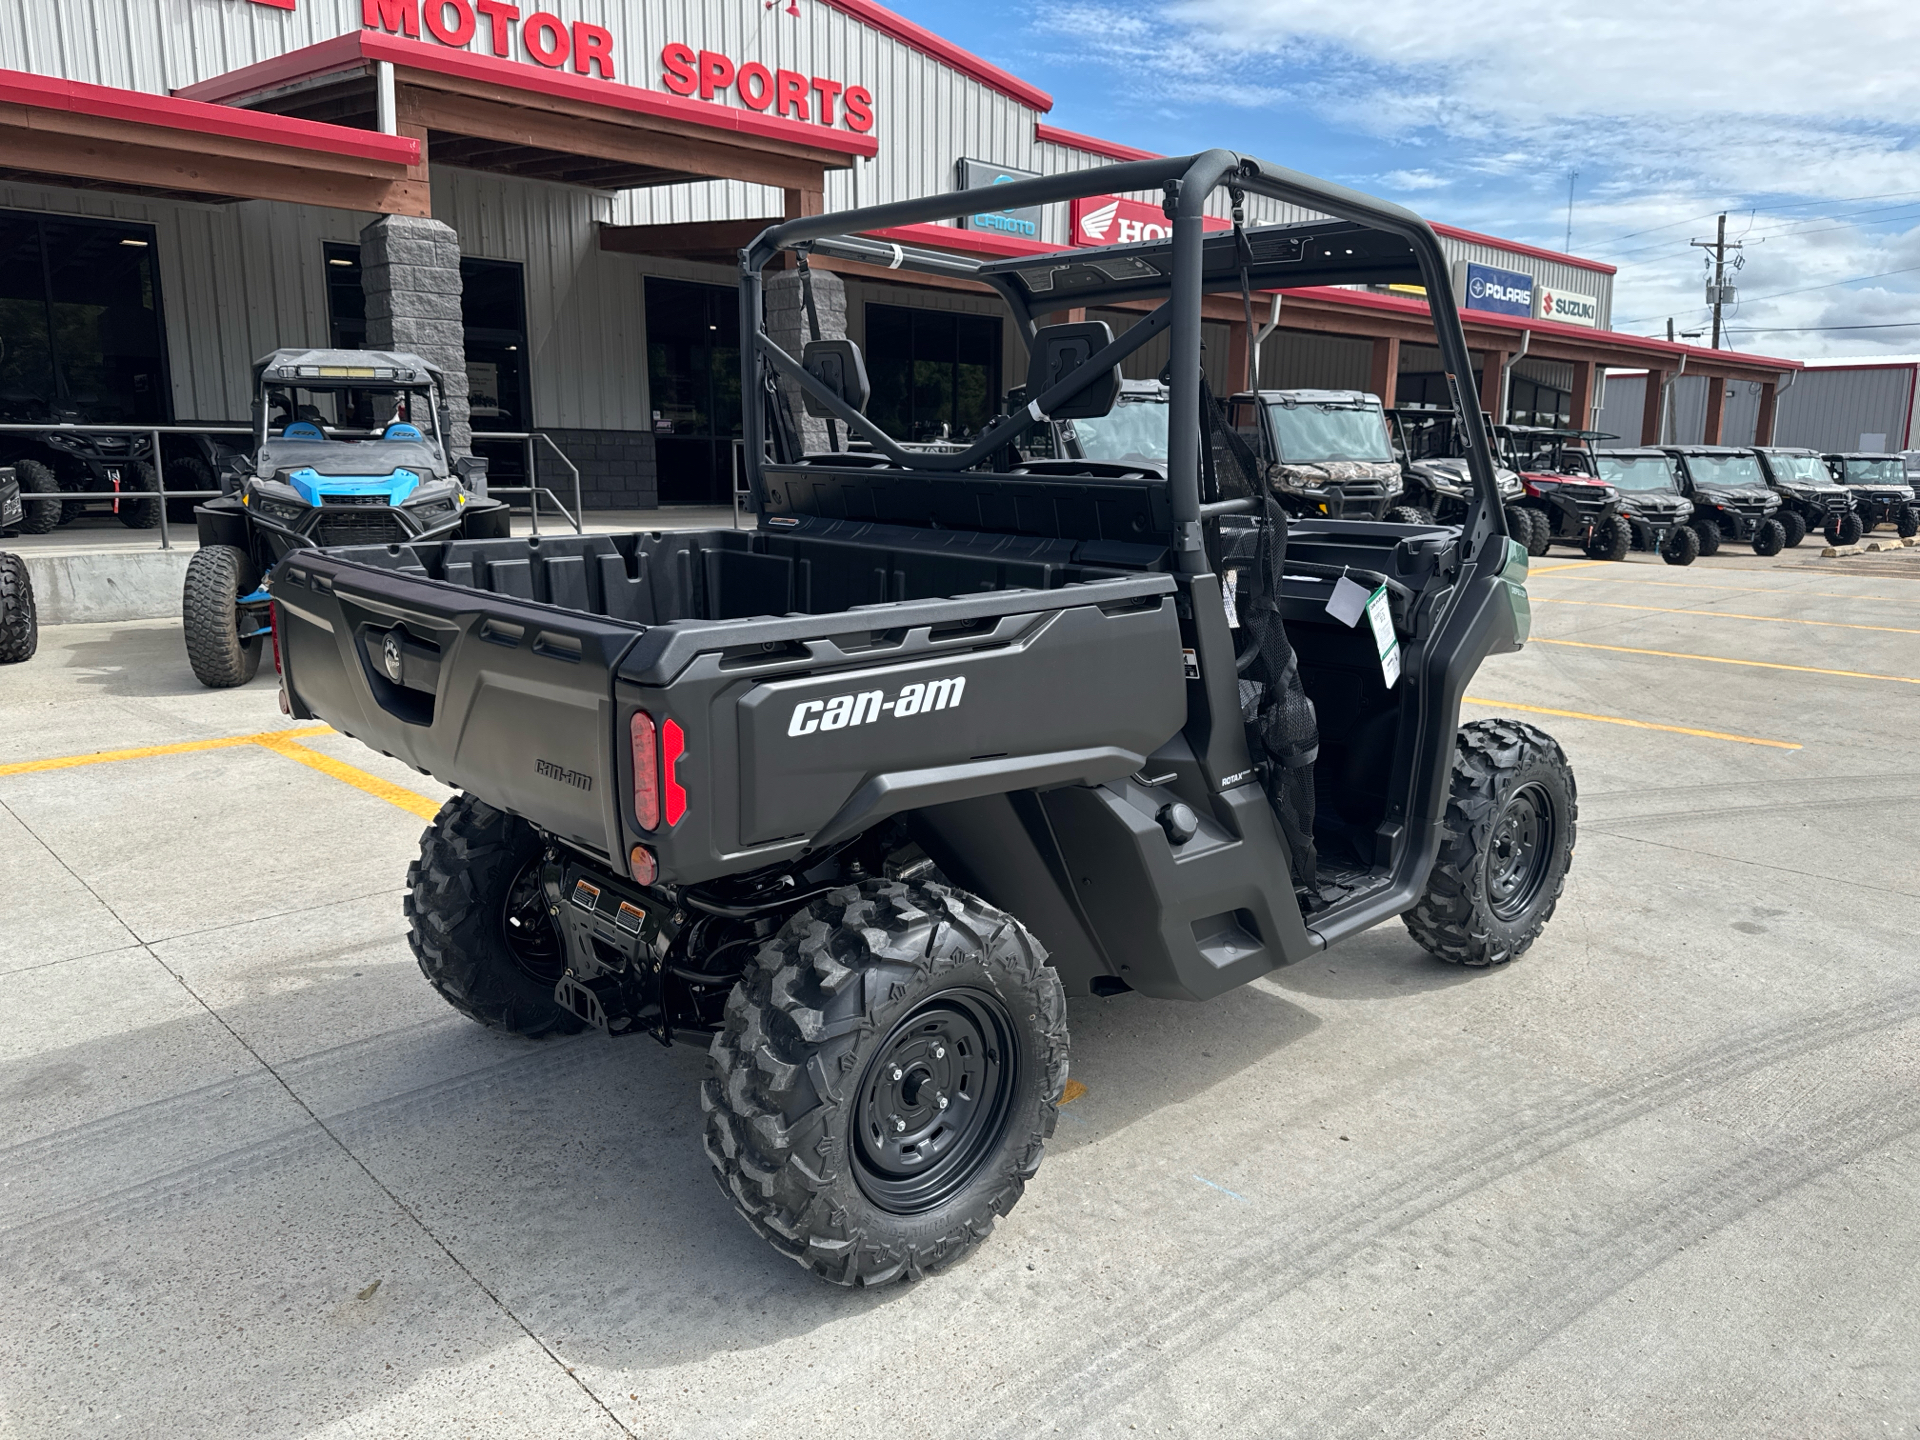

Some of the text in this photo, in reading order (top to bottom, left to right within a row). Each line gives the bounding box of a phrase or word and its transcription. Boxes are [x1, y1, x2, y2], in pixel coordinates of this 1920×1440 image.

[363, 0, 874, 132] MOTOR SPORTS
[973, 212, 1036, 236] CFMOTO
[1485, 282, 1531, 306] POLARIS
[1555, 297, 1595, 320] SUZUKI
[787, 676, 967, 738] can-am
[1221, 771, 1243, 787] ROTAX
